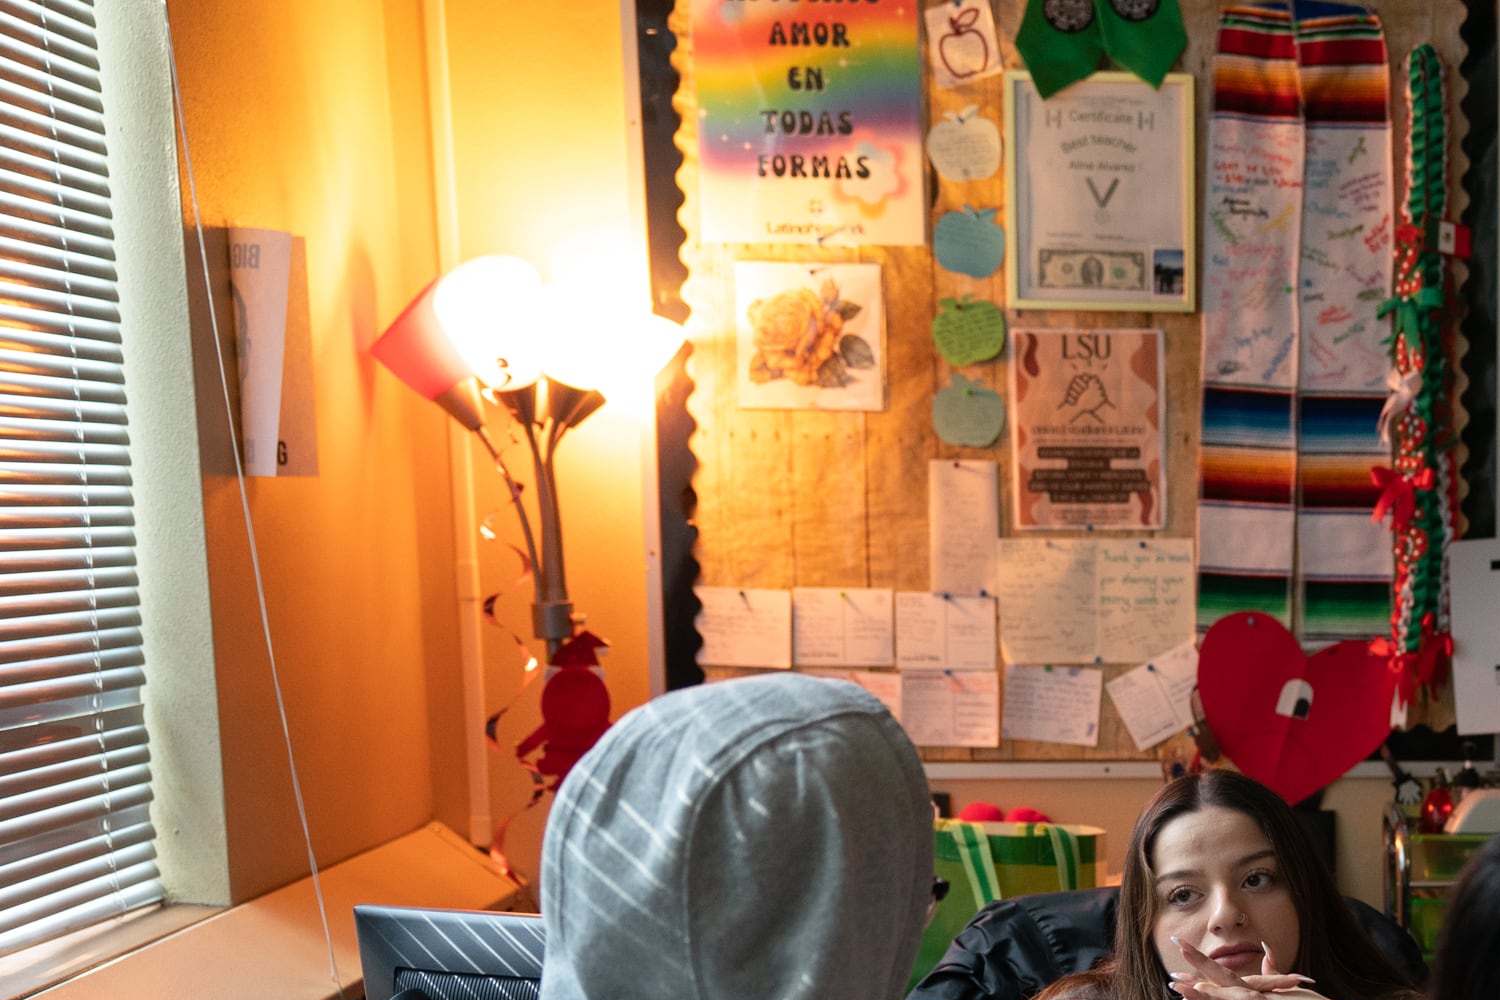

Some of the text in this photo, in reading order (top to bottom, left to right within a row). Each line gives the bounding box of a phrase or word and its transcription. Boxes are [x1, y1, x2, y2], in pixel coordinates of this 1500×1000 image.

[769, 21, 851, 47] AMOR
[787, 66, 825, 91] EN
[761, 110, 854, 136] TODAS
[1068, 109, 1134, 125] Certificate
[758, 154, 871, 179] FORMAS
[1061, 333, 1112, 361] LSU
